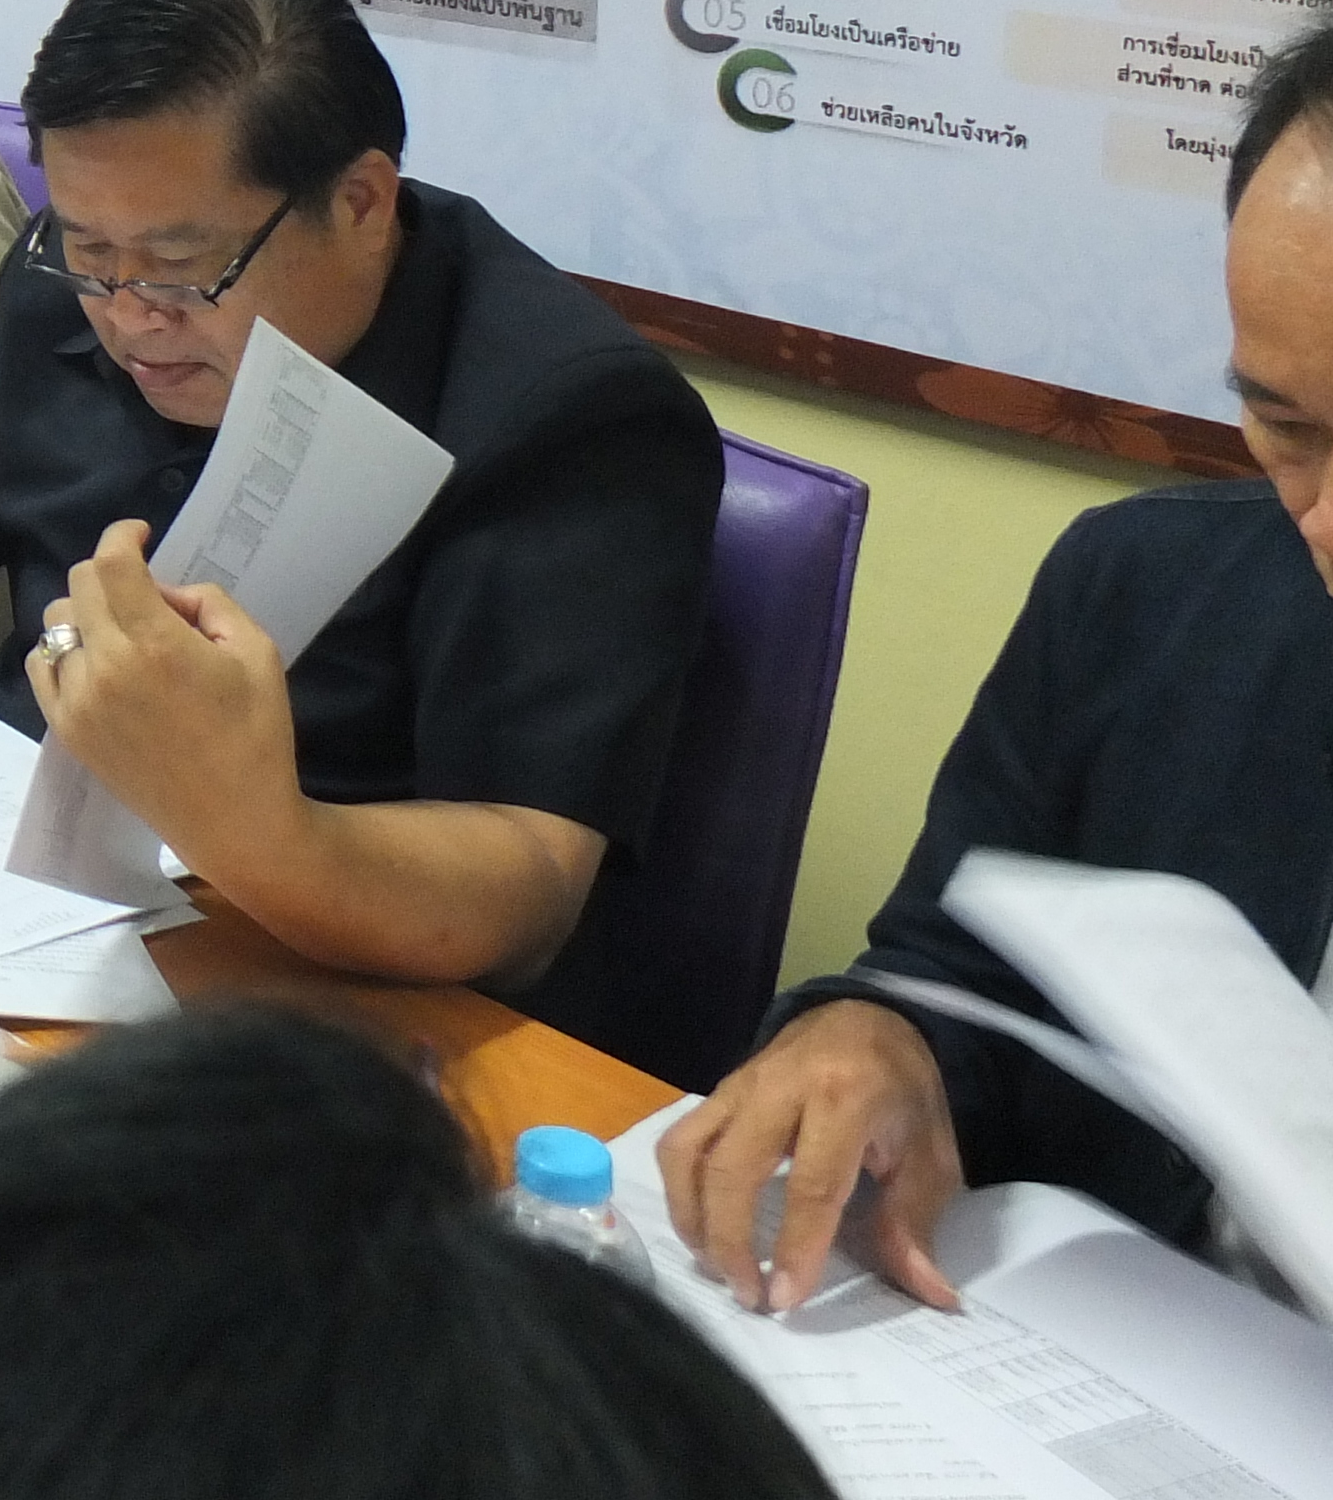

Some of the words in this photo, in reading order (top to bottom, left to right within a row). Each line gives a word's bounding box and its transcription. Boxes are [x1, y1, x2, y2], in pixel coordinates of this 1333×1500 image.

[764, 4, 962, 57] เชื่อมโยงเป็นเครือข่าย
[751, 76, 798, 114] 06
[819, 97, 1030, 151] ช่วยเหลือคนในจังหวัด
